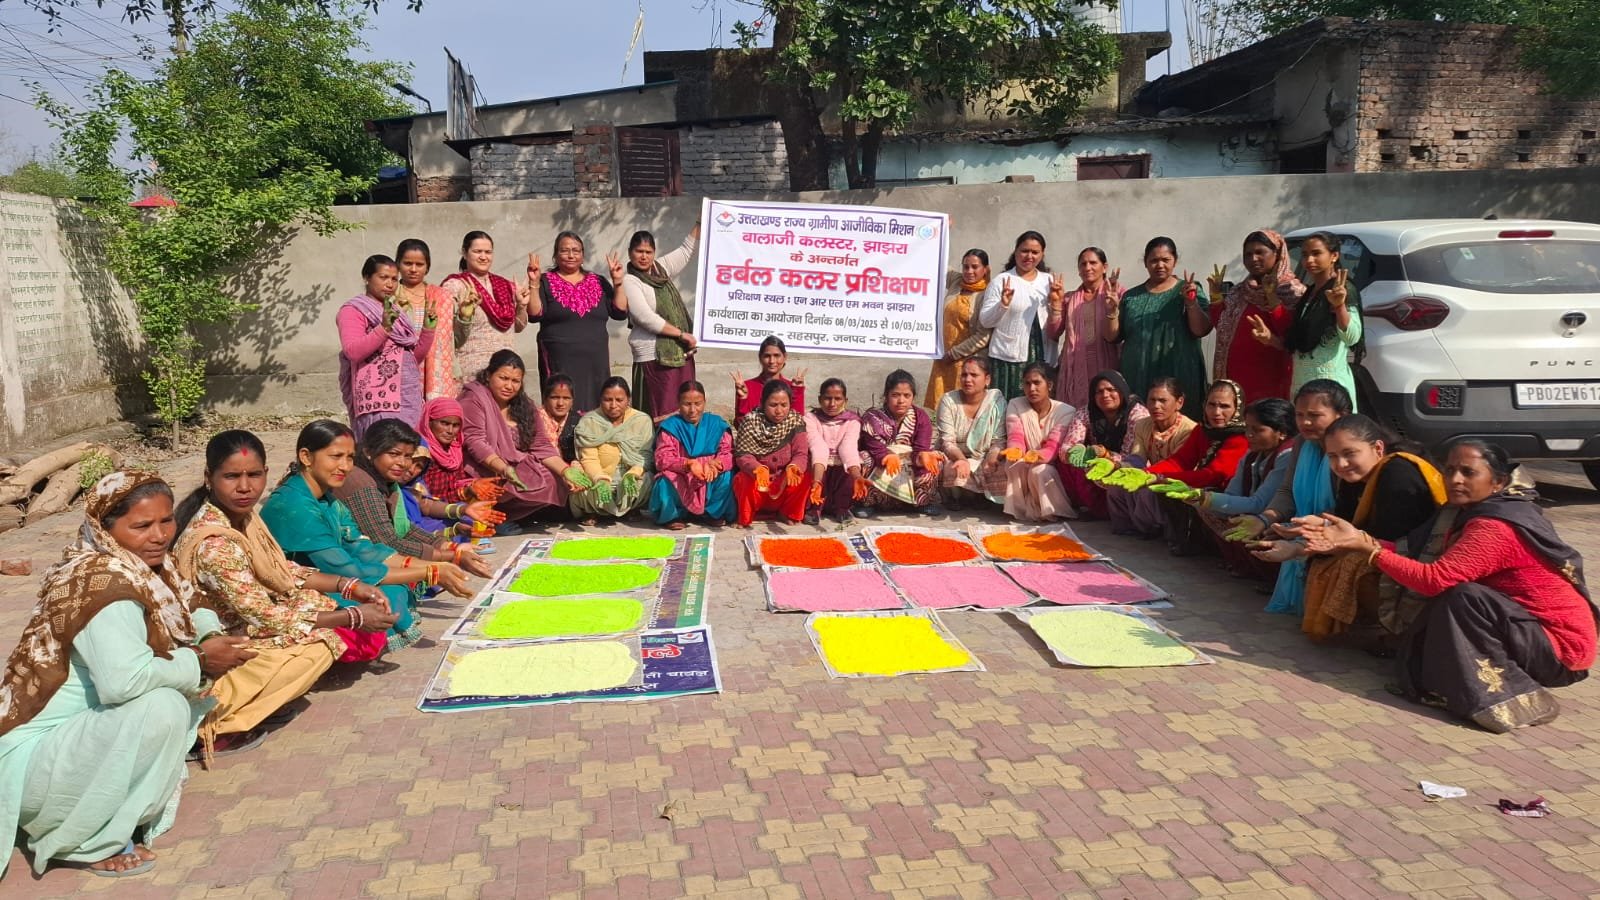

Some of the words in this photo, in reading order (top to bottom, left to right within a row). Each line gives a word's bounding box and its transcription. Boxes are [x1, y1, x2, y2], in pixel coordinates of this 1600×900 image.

[738, 213, 782, 228] उत्तराखण्ड
[784, 217, 806, 228] राज्य
[808, 215, 838, 231] ग्रामीण
[841, 216, 887, 234] आजीविका
[889, 219, 915, 236] मिशन
[790, 250, 804, 262] के
[807, 254, 859, 266] अन्तर्गत
[863, 241, 908, 255] झाझरा
[716, 258, 775, 286] हर्बल
[779, 268, 840, 290] कलर
[845, 267, 930, 296] प्रशिक्षण
[728, 289, 761, 302] प्रशिक्षण
[763, 293, 785, 304] स्थल
[793, 296, 807, 306] एन
[809, 298, 827, 307] आर
[828, 299, 844, 308] एल
[845, 300, 859, 309] एम
[861, 302, 884, 310] भवन
[886, 303, 915, 312] झाझरा
[707, 306, 748, 321] कार्यशाला
[750, 311, 763, 321] का
[765, 311, 802, 325] आयोजन
[804, 312, 833, 326] दिनांक
[835, 316, 878, 329] 08/03/2025
[880, 317, 889, 330] से
[891, 320, 933, 333] 10/03/2025
[713, 323, 747, 336] विकास
[833, 333, 867, 344] जनपद
[879, 335, 919, 351] देहरादून
